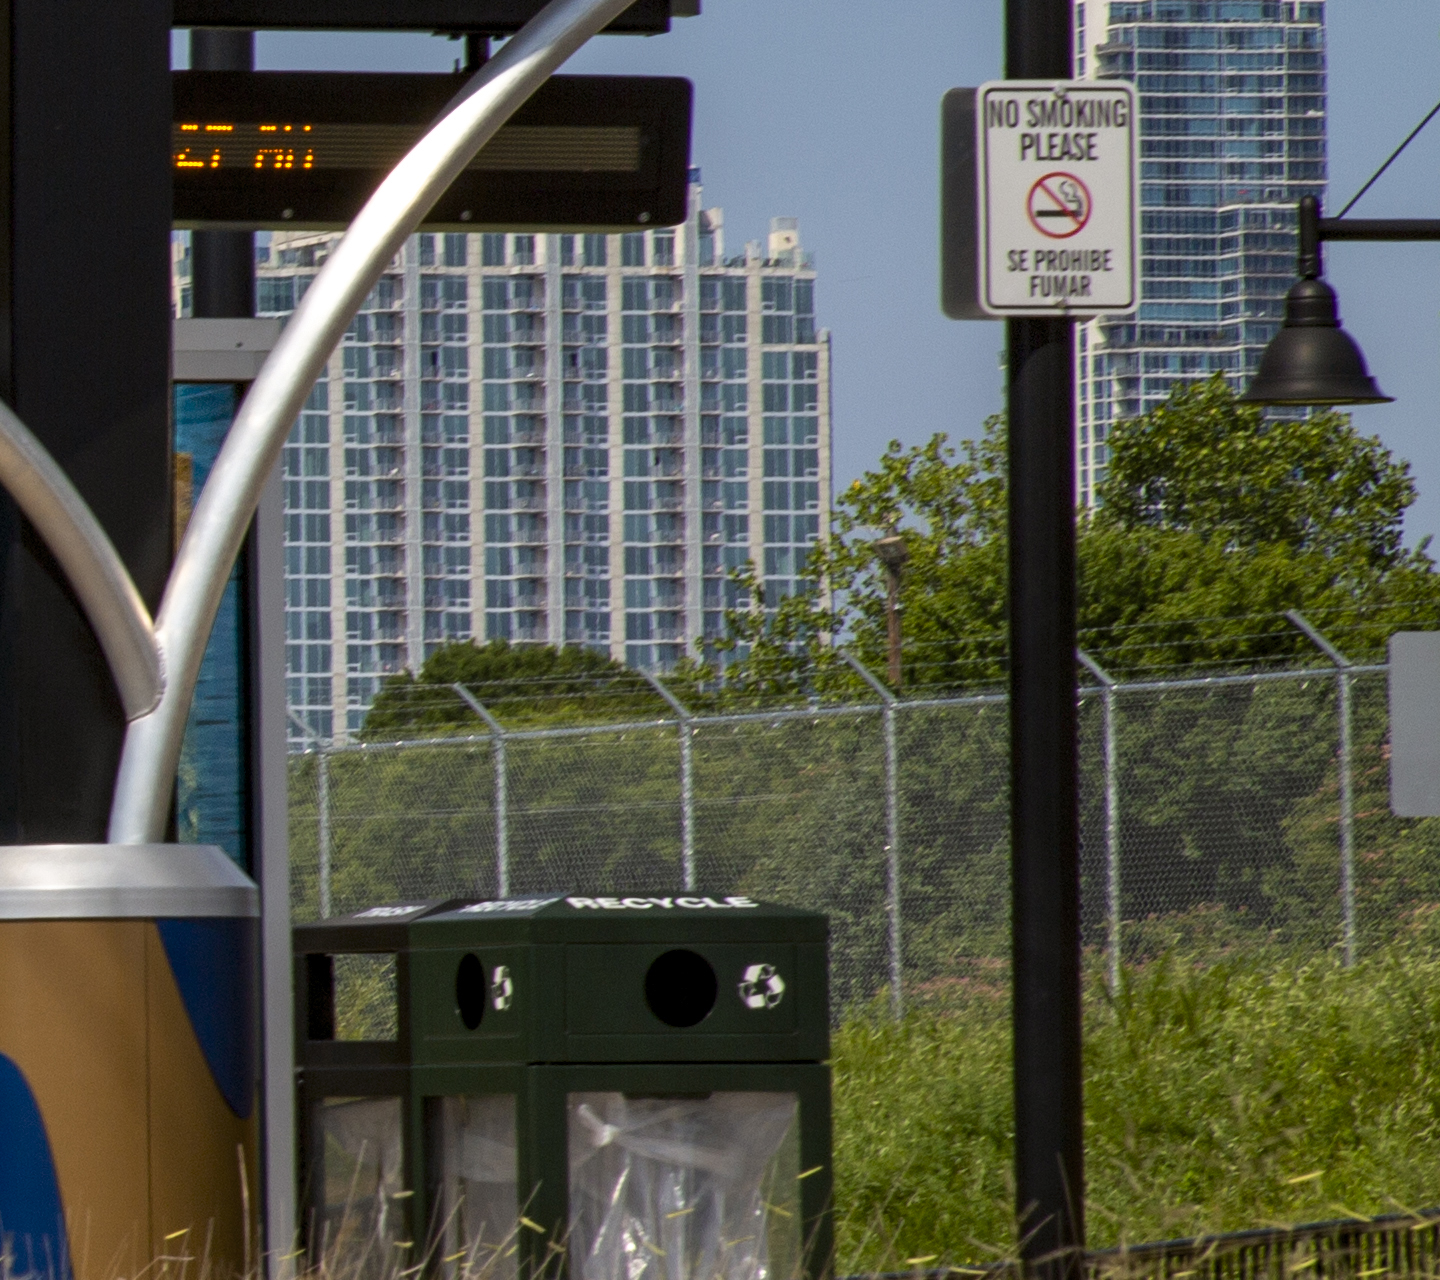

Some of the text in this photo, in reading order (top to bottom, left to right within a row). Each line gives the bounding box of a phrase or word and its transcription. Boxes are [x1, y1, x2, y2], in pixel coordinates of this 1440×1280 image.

[988, 98, 1128, 128] NO SMOKING
[1019, 132, 1099, 161] PLEASE
[1006, 248, 1114, 272] SE PROHIBE
[1029, 275, 1092, 298] FUMAR
[565, 896, 760, 909] RECYCLE
